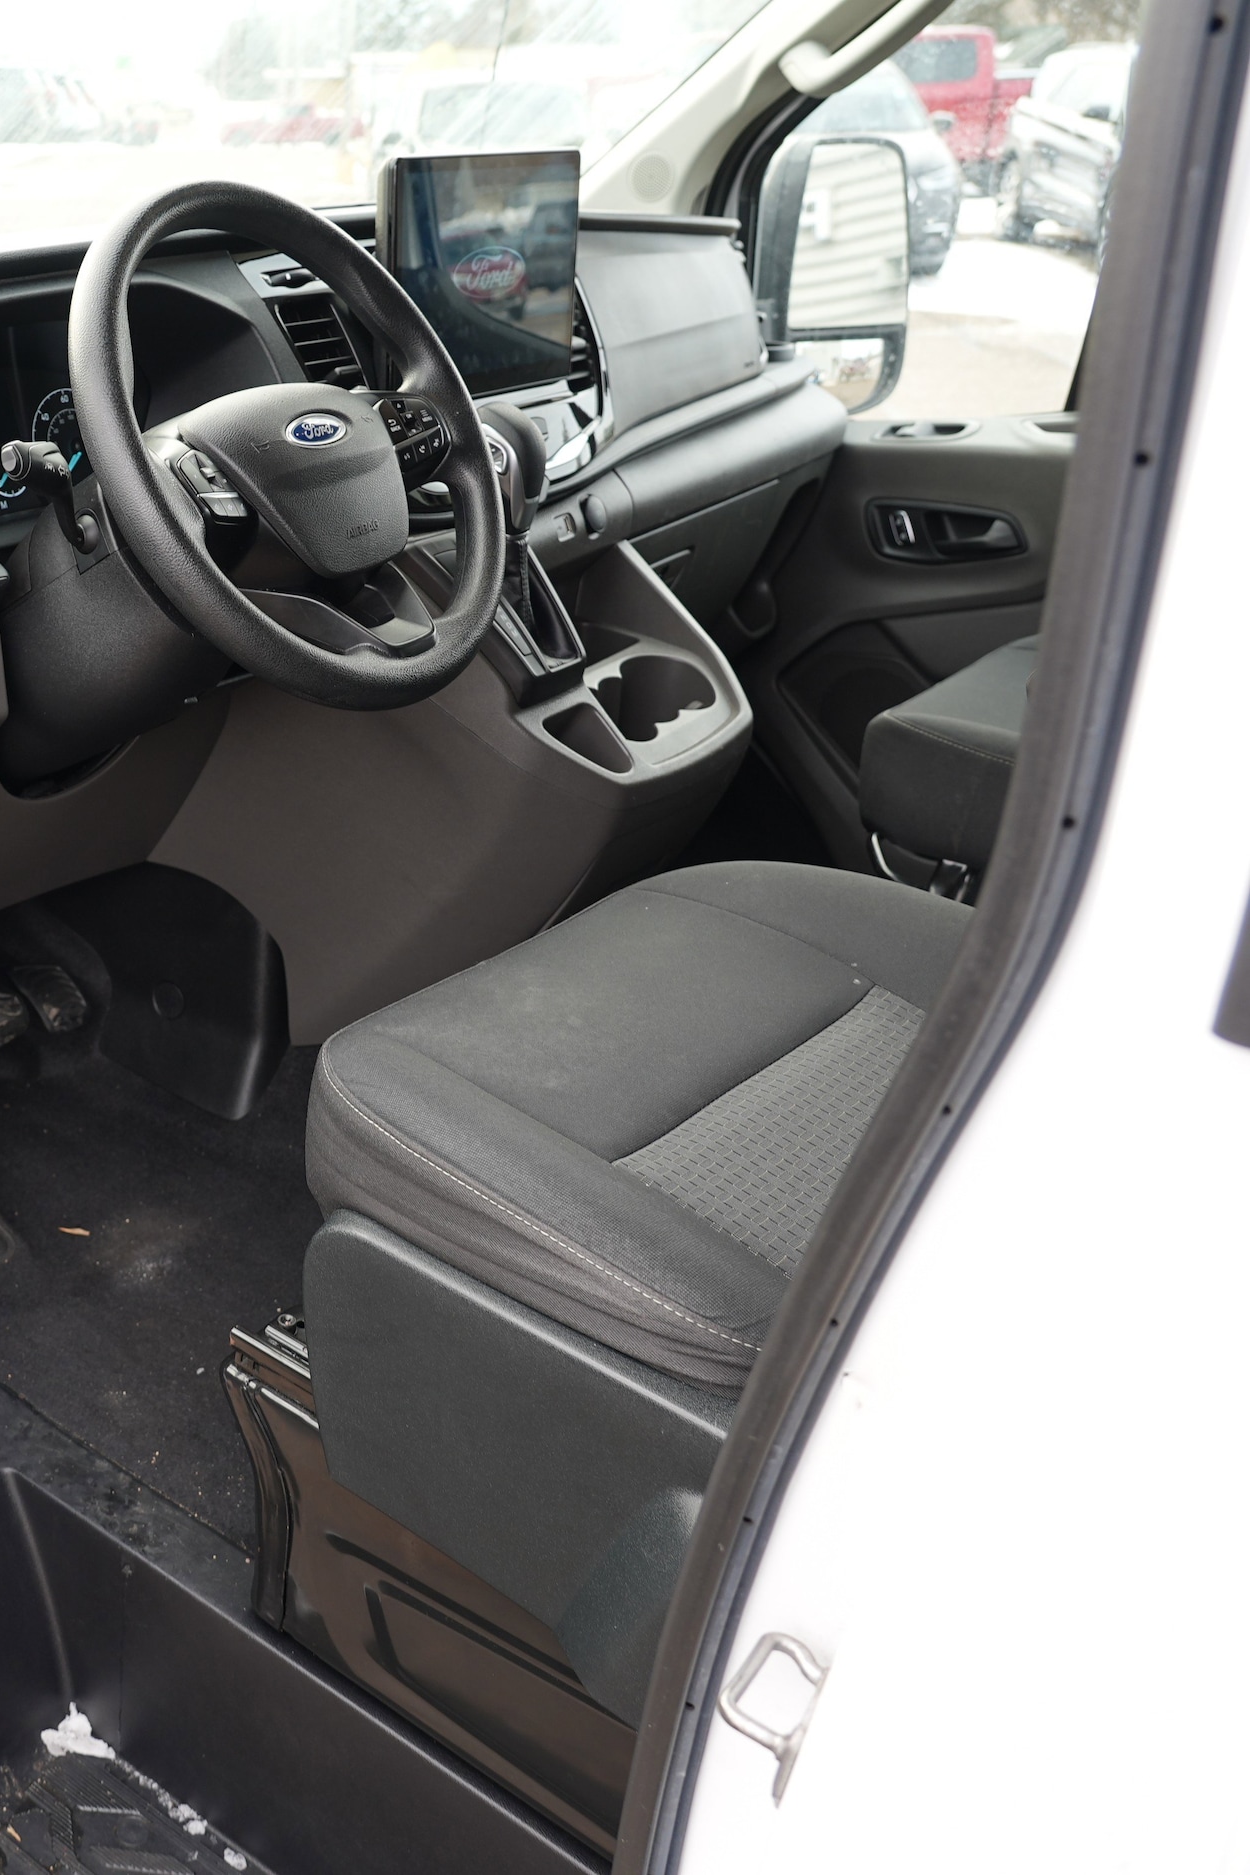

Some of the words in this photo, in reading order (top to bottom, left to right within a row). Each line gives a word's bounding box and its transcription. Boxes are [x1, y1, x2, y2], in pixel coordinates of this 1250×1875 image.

[466, 254, 517, 290] Ford
[301, 422, 334, 440] Ford
[346, 518, 380, 540] AIRBAG
